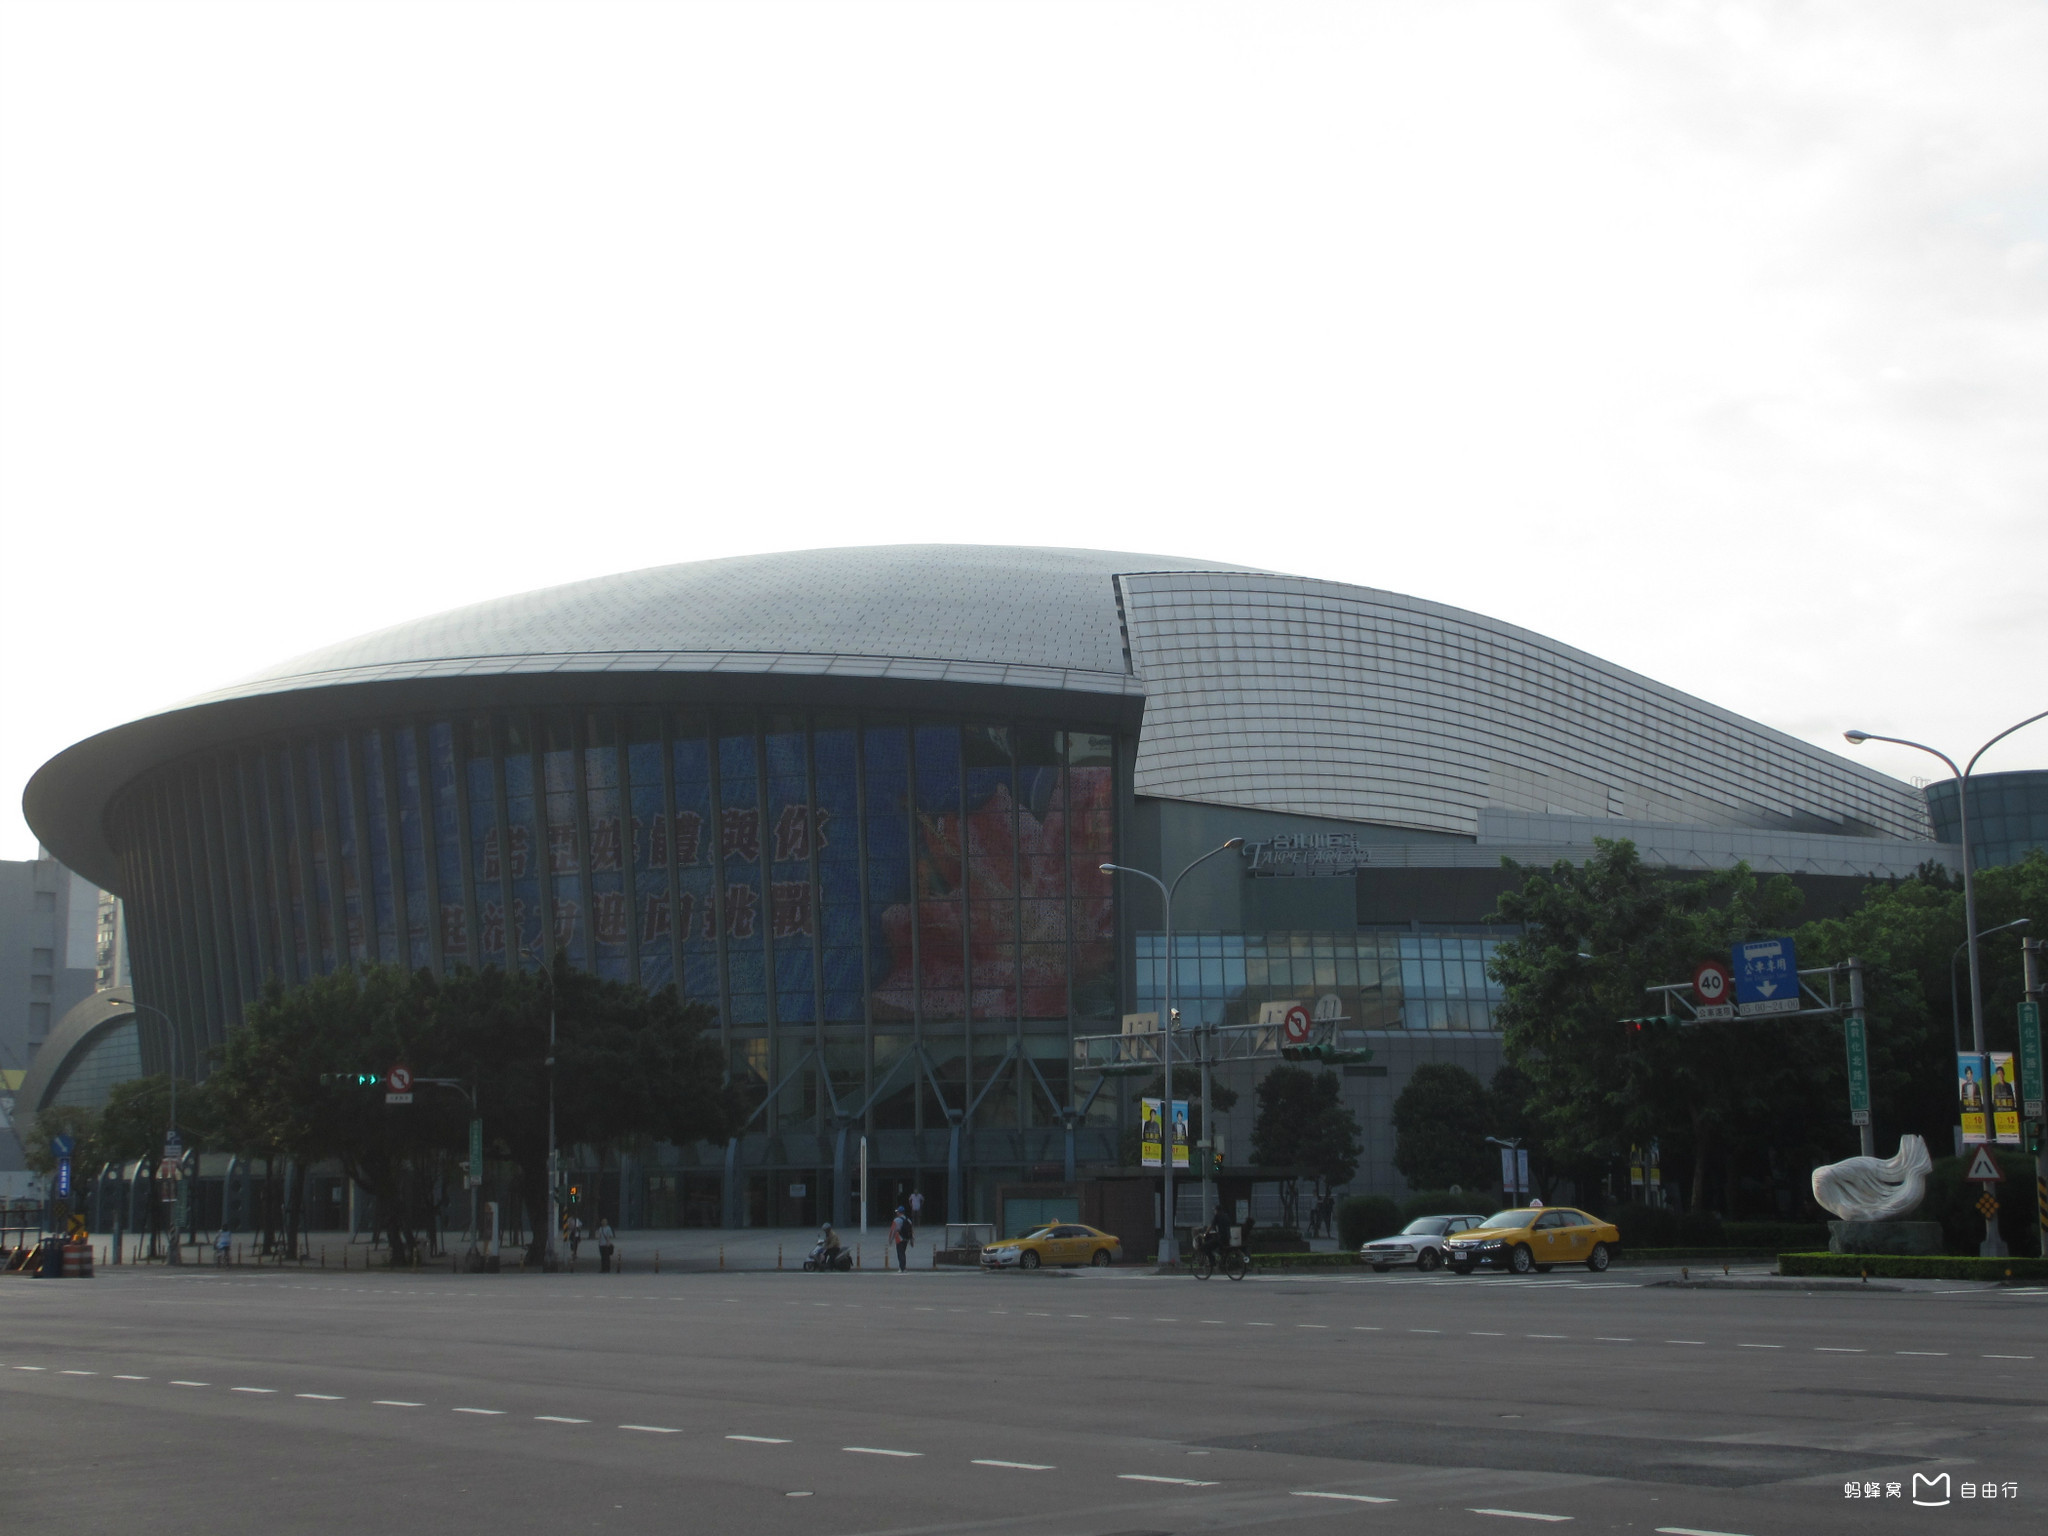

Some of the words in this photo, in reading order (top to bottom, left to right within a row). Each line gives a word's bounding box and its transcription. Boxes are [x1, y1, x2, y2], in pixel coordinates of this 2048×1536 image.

[1744, 957, 1787, 975] 公車專用
[1701, 975, 1721, 990] 40
